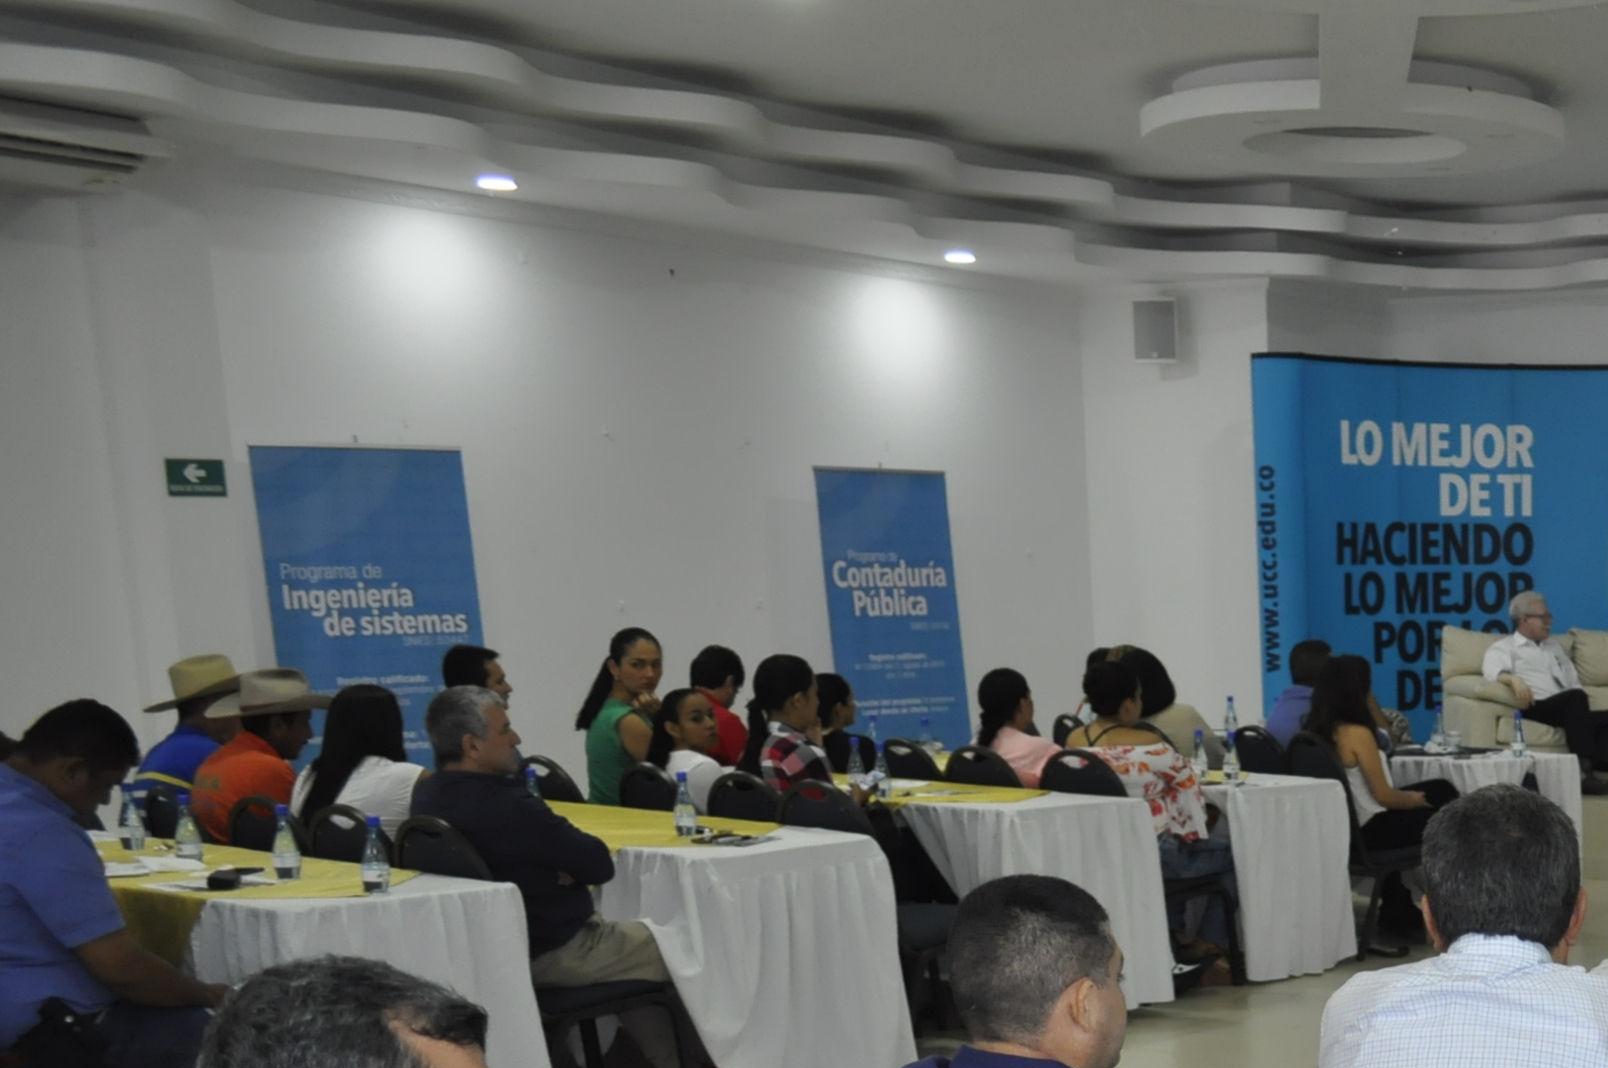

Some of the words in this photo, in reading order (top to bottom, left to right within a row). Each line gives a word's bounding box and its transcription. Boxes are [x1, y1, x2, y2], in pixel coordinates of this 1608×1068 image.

[1340, 420, 1384, 467] LO
[1391, 422, 1535, 469] MEJOR
[1439, 473, 1492, 517] DE
[1496, 474, 1533, 517] TI
[1336, 521, 1534, 567] HACIENDO
[280, 563, 358, 583] Programa
[362, 563, 383, 579] de
[832, 558, 948, 588] Contaduría
[1257, 465, 1281, 673] www.ucc.edu.co
[281, 582, 414, 617] Ingeniería
[853, 588, 928, 617] Pública
[1343, 571, 1385, 615] LO
[323, 610, 356, 637] de
[361, 609, 468, 636] sistemas
